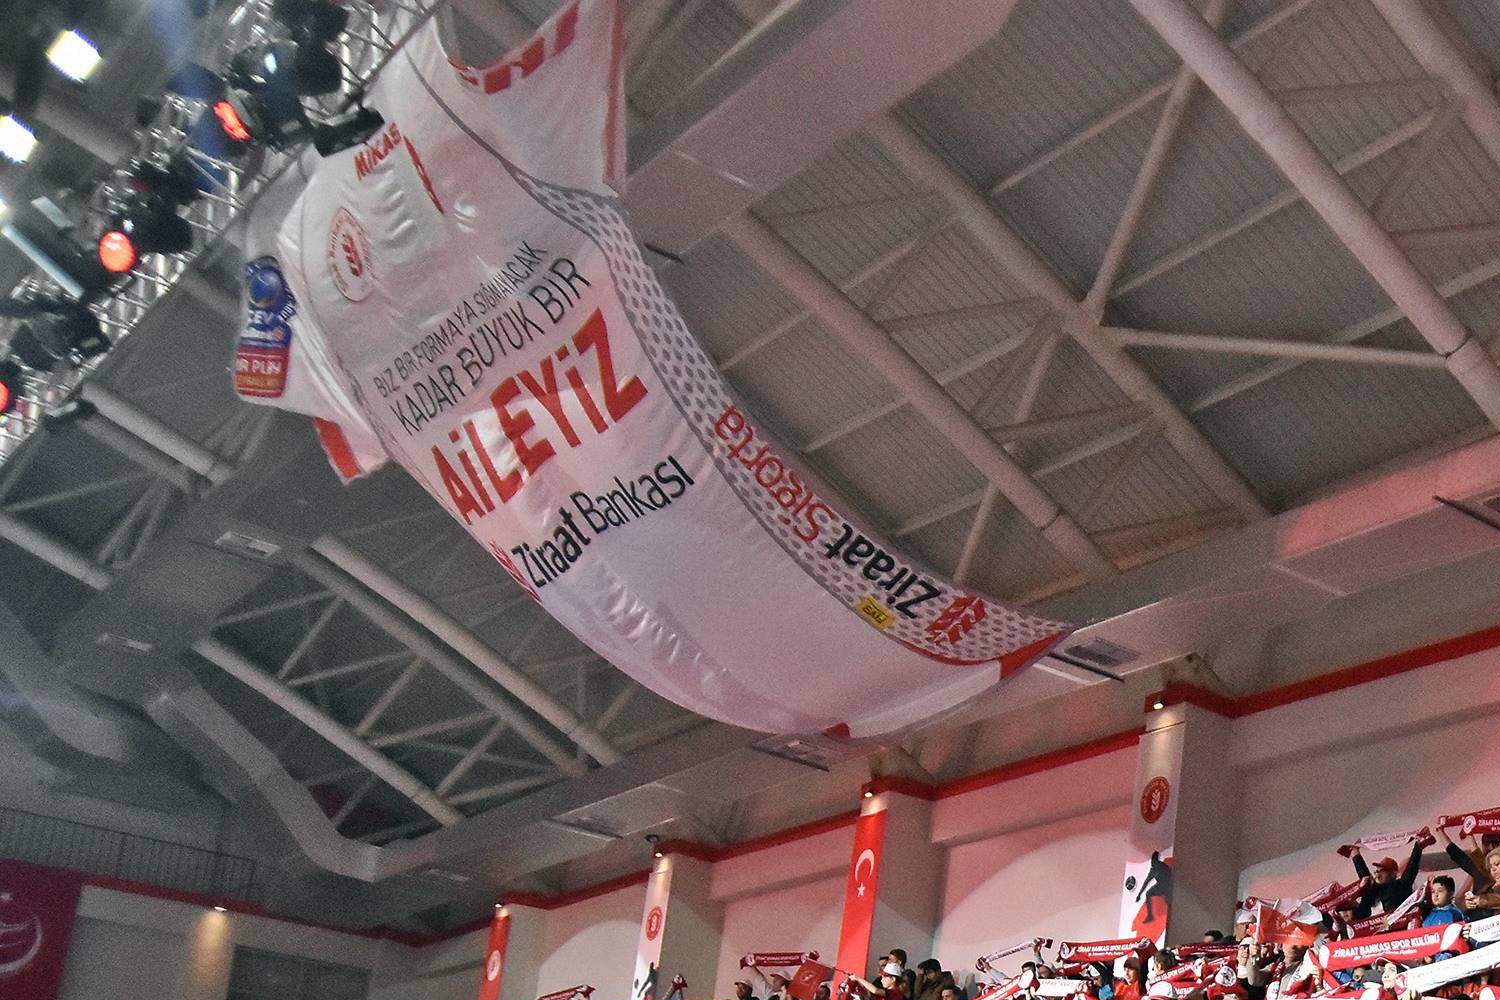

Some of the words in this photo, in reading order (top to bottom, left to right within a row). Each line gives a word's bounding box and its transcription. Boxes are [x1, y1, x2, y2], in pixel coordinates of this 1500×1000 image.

[389, 365, 466, 436] KADAR
[456, 301, 546, 387] BÜYÜK
[512, 506, 591, 588] Ziraat
[570, 455, 695, 535] Bankası
[714, 405, 840, 543] Sigorta
[824, 522, 941, 619] Ziraat
